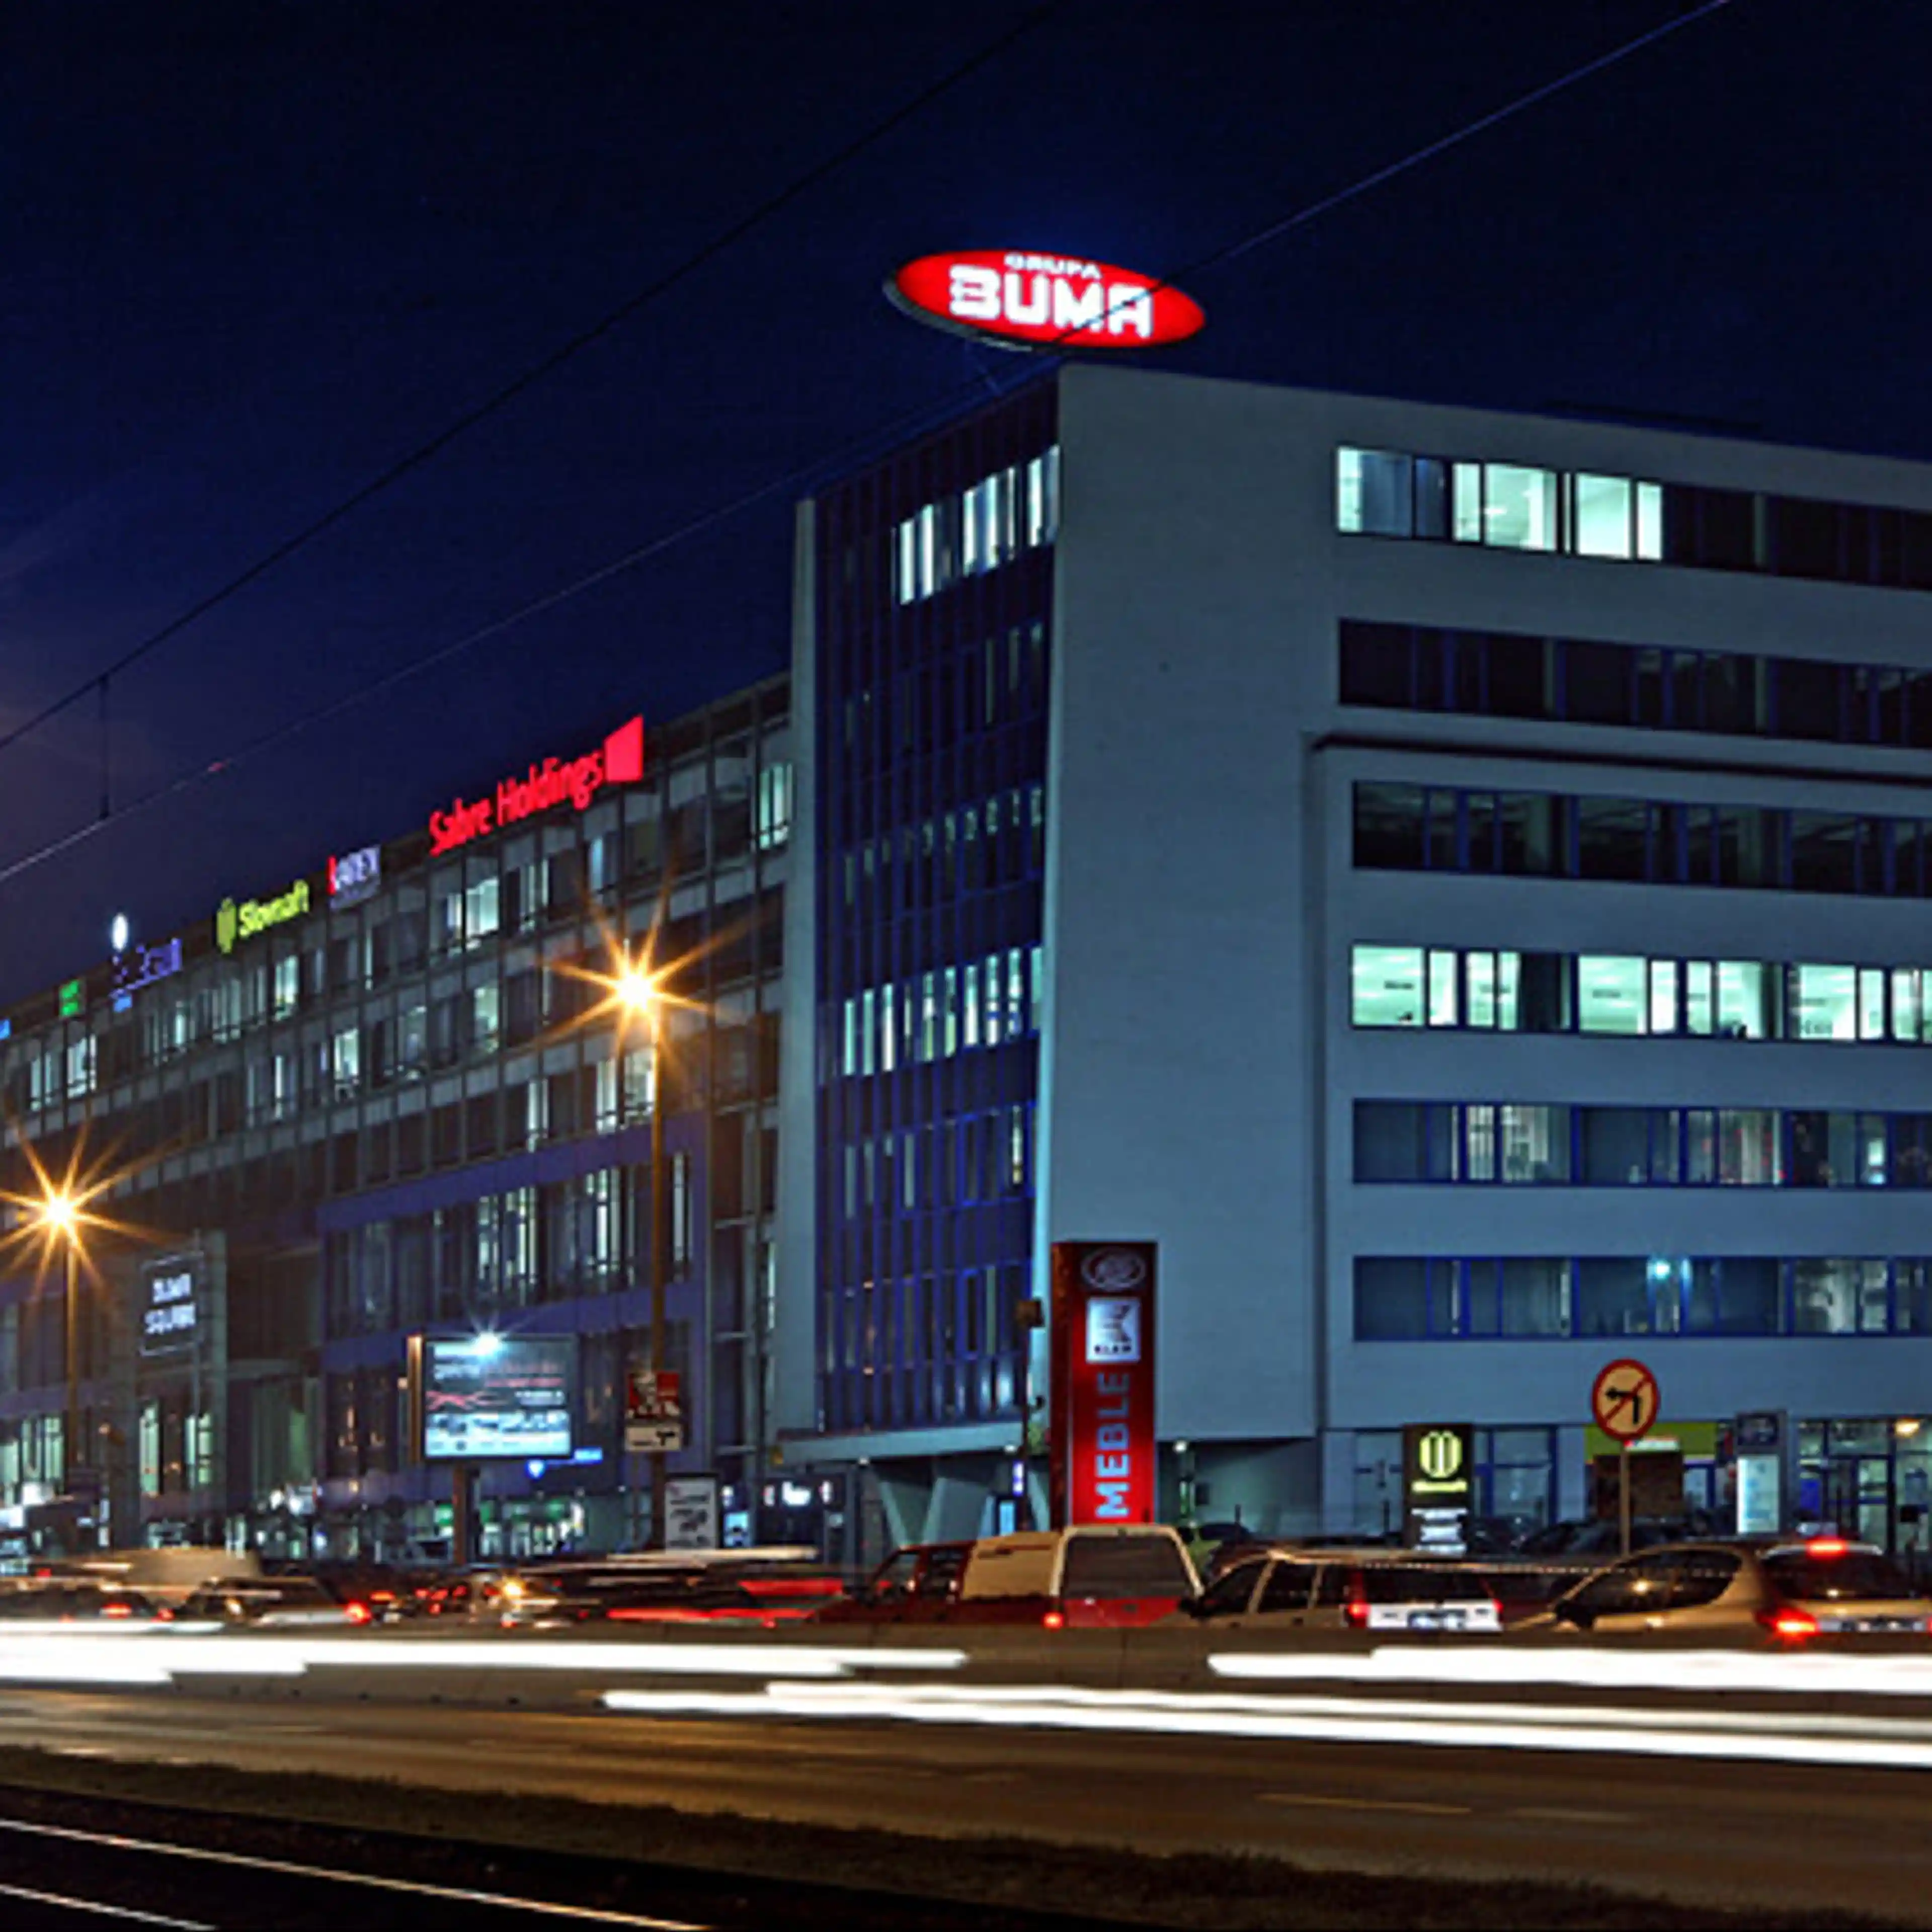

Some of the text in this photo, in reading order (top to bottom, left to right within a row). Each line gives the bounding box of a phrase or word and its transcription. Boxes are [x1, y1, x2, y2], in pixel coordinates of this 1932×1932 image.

[948, 264, 1154, 338] BUMA
[1004, 252, 1102, 280] GRUPA
[429, 750, 604, 856] Sabre Holdings
[1095, 1371, 1132, 1519] MEBLE
